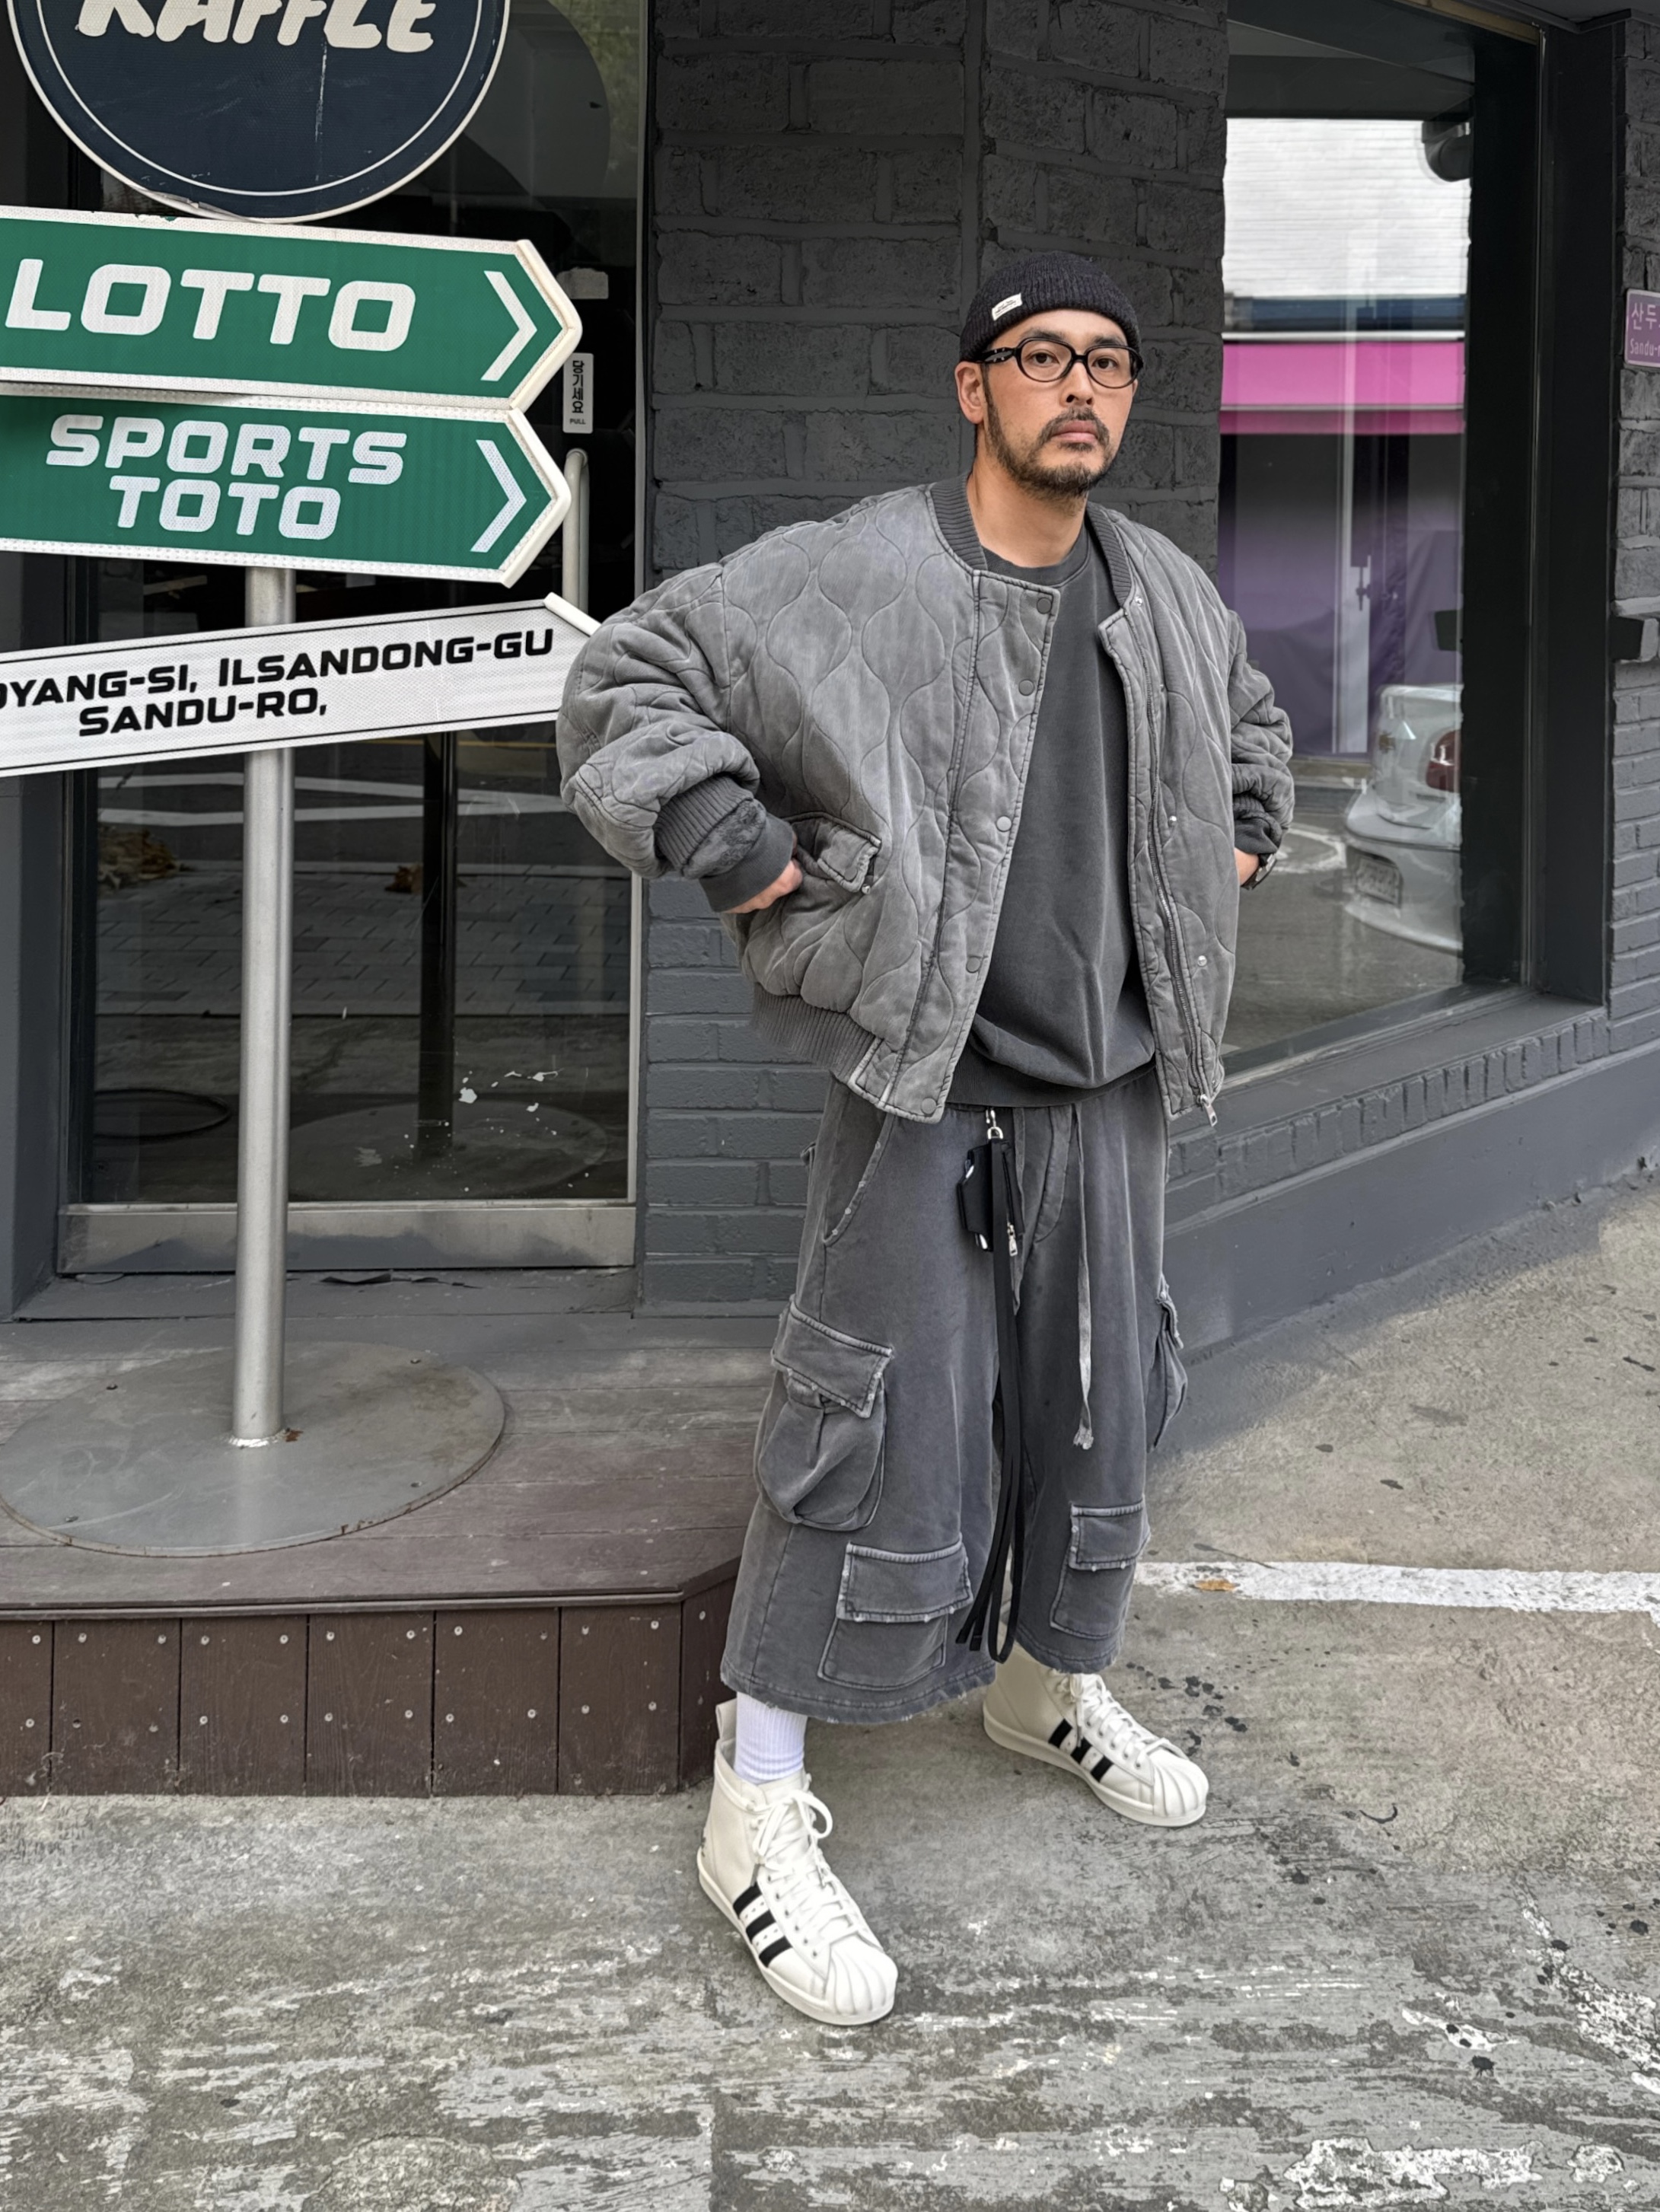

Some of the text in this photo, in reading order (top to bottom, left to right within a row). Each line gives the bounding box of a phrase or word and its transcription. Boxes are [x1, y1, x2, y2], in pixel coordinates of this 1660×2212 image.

[5, 258, 416, 352] LOTTO
[1630, 302, 1660, 330] 산두
[572, 360, 585, 414] 당기세요
[46, 415, 408, 486] SPORTS
[109, 475, 342, 540] TOTO
[0, 629, 554, 709] YANG-SI, ILSANDONG-GU
[79, 687, 327, 737] SANDU-RO,
